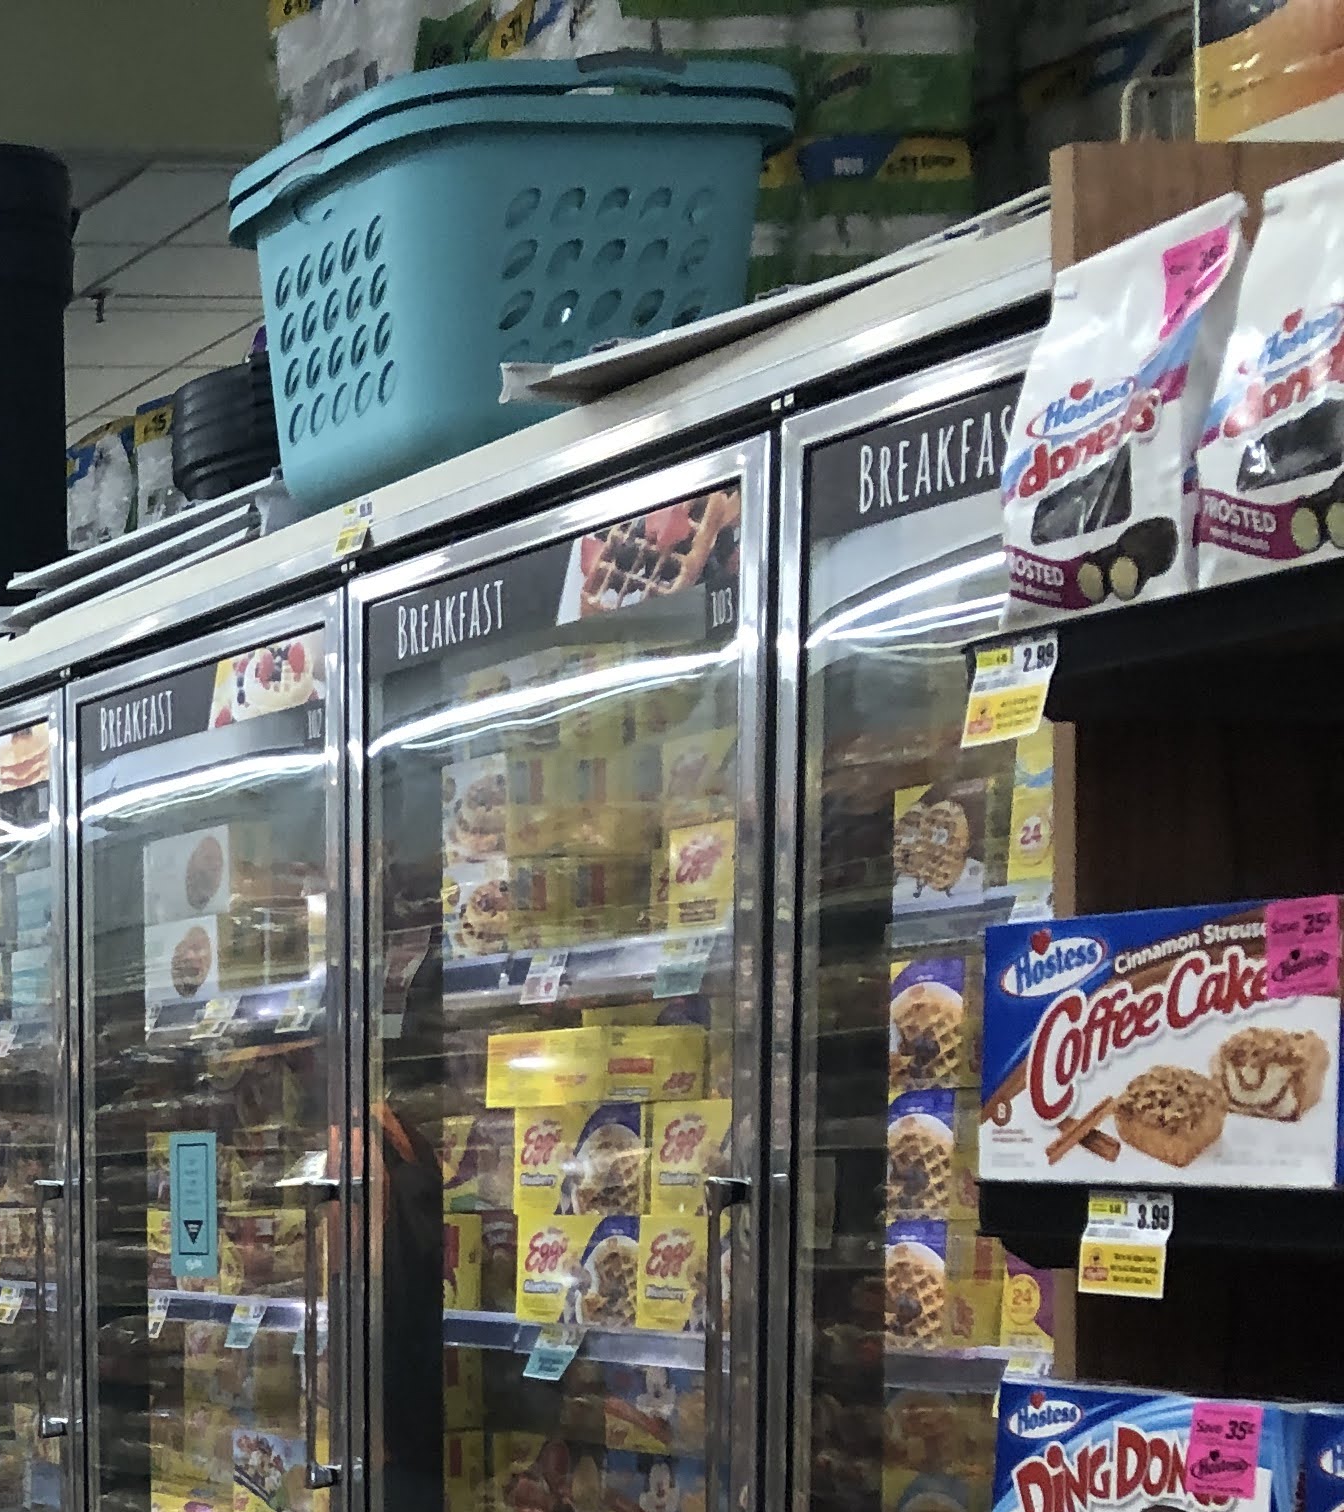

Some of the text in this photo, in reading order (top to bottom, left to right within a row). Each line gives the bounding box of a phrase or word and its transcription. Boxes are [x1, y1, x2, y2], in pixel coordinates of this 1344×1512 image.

[858, 404, 1012, 514] BREAKFAS
[1009, 555, 1065, 587] OSTED
[397, 579, 504, 661] BREAKFAST
[99, 690, 173, 751] BREAKFAST
[1013, 941, 1099, 993] Hostess
[1114, 920, 1269, 974] Cinnamon Streuse
[1029, 954, 1269, 1119] Coffee Cake
[1137, 1204, 1170, 1230] 3.99
[524, 1231, 570, 1274] Eggo
[1016, 1406, 1079, 1434] Hostess
[1195, 1420, 1223, 1434] Save
[1117, 1427, 1231, 1504] DON
